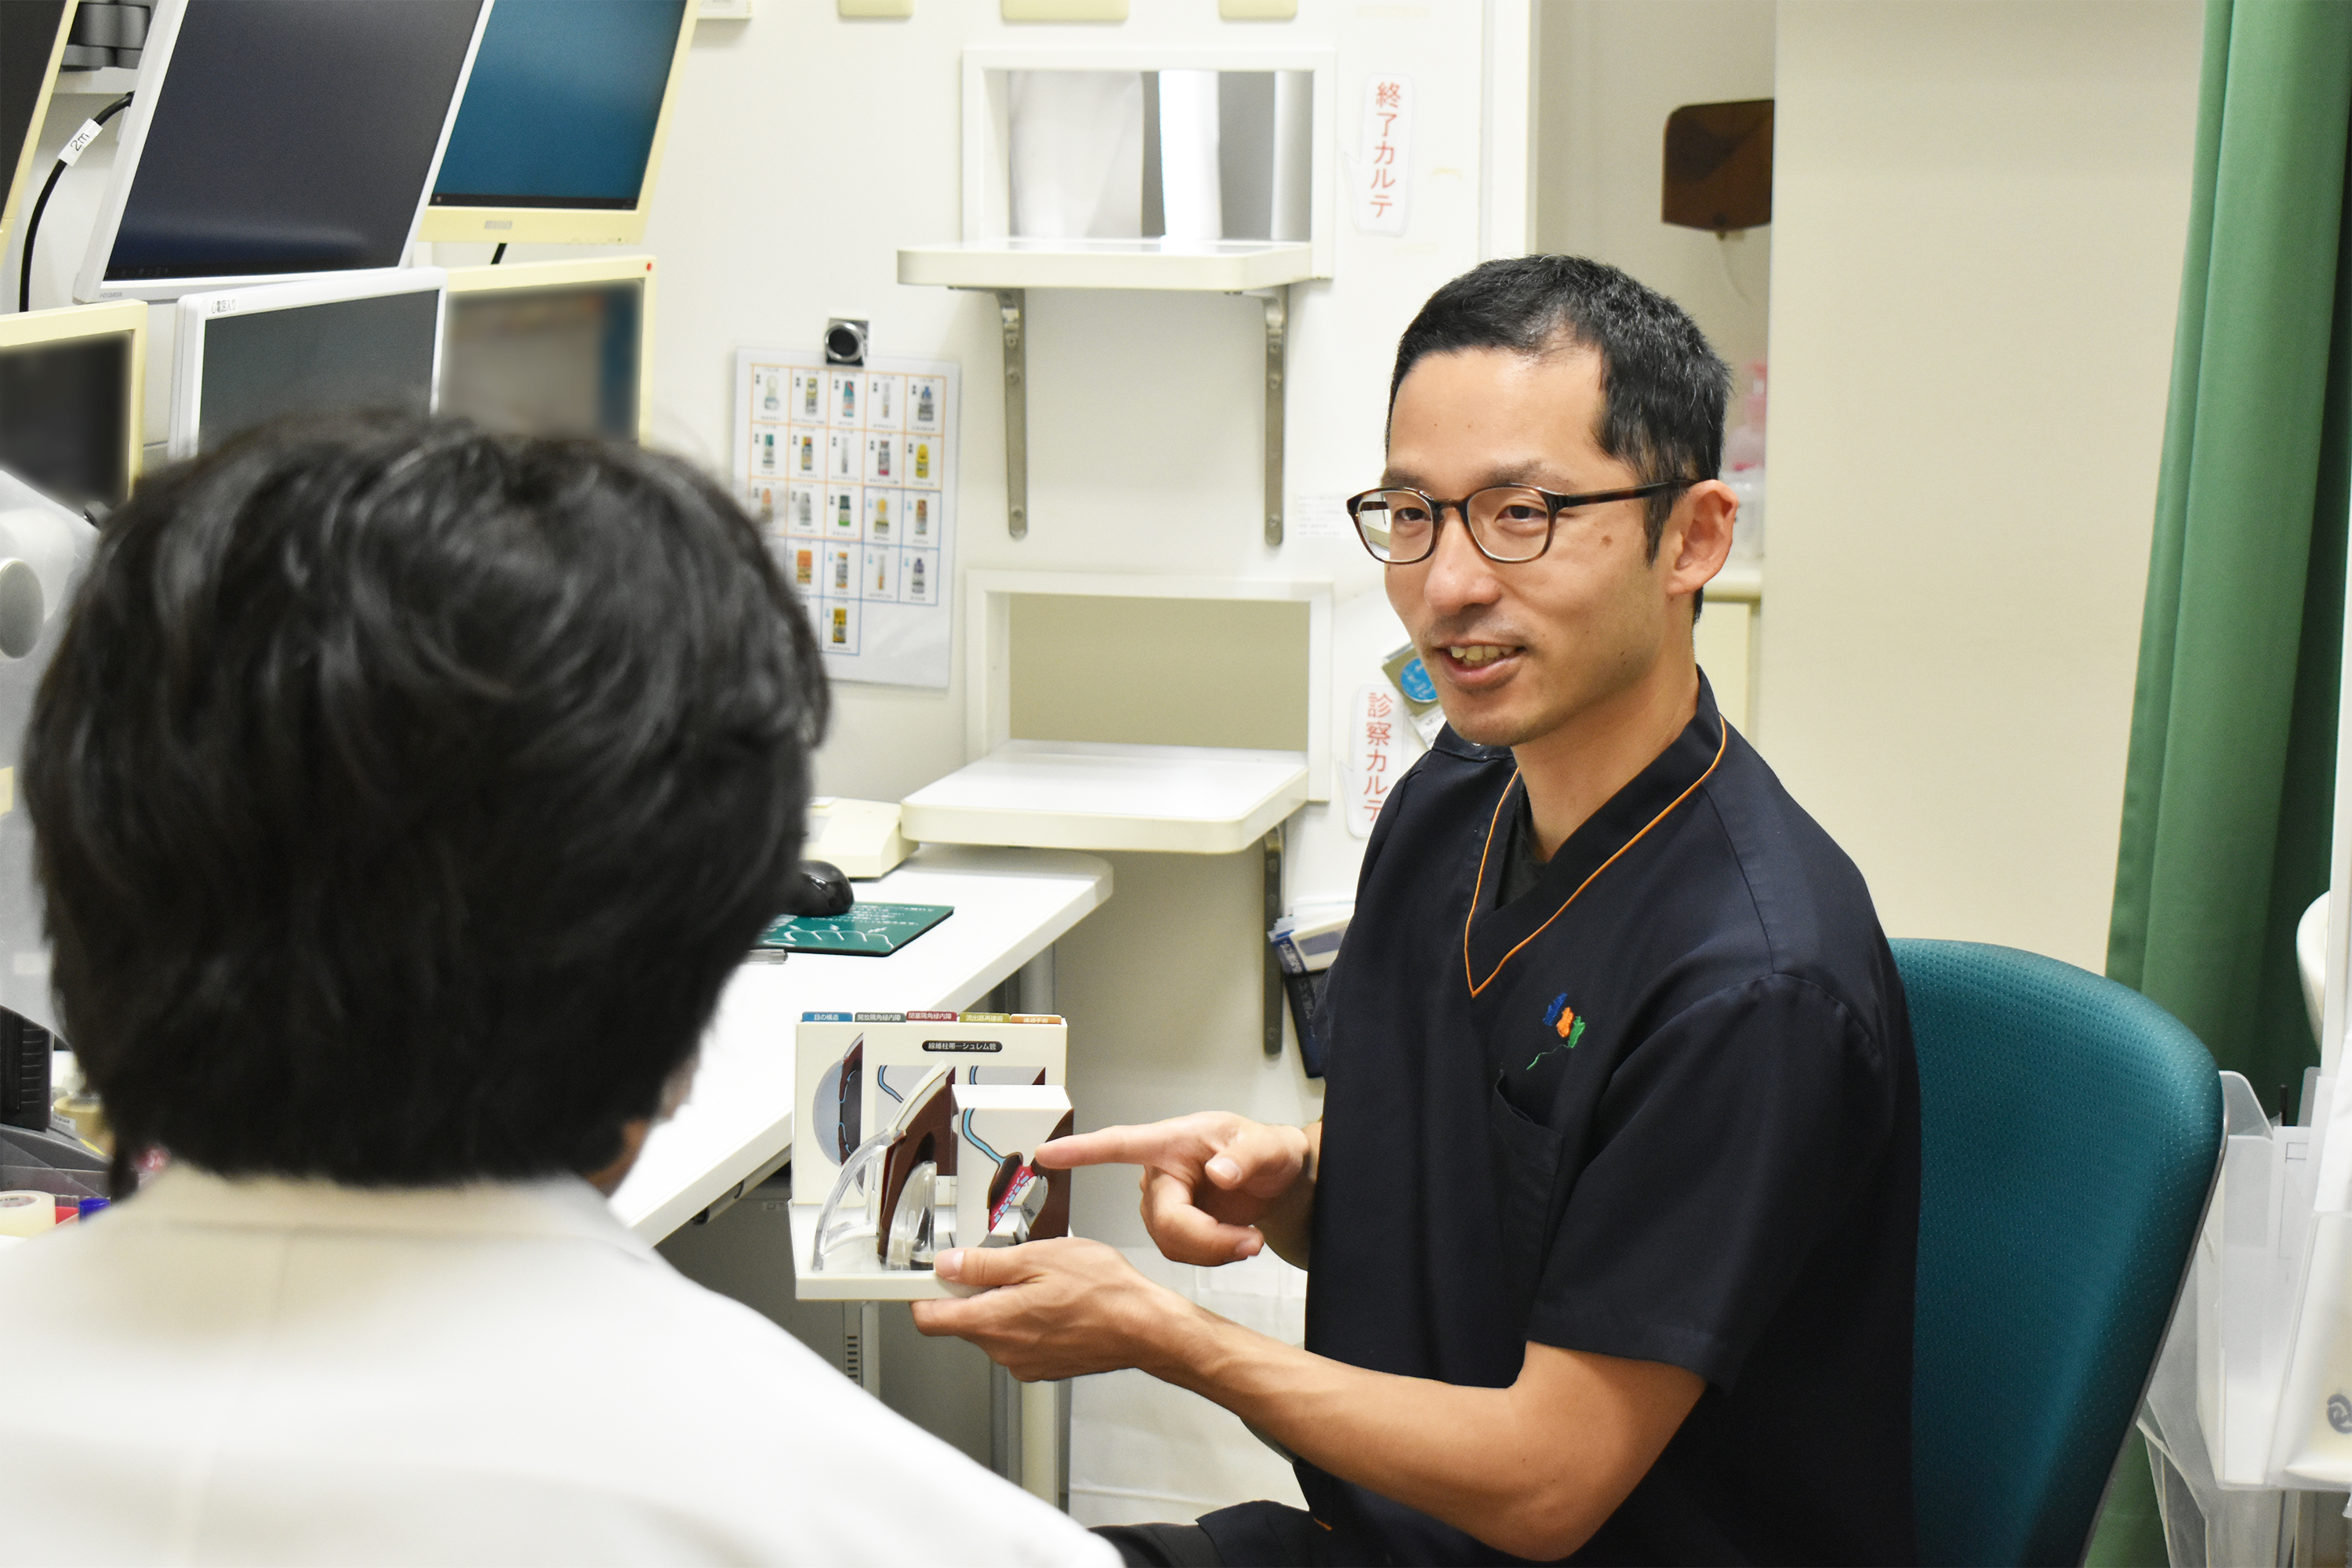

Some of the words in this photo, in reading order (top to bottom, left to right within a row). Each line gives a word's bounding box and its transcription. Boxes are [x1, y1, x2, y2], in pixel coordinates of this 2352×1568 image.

[70, 132, 89, 151] 2m
[1370, 81, 1401, 218] 終了カルテ
[1363, 692, 1393, 822] 診察カルテ
